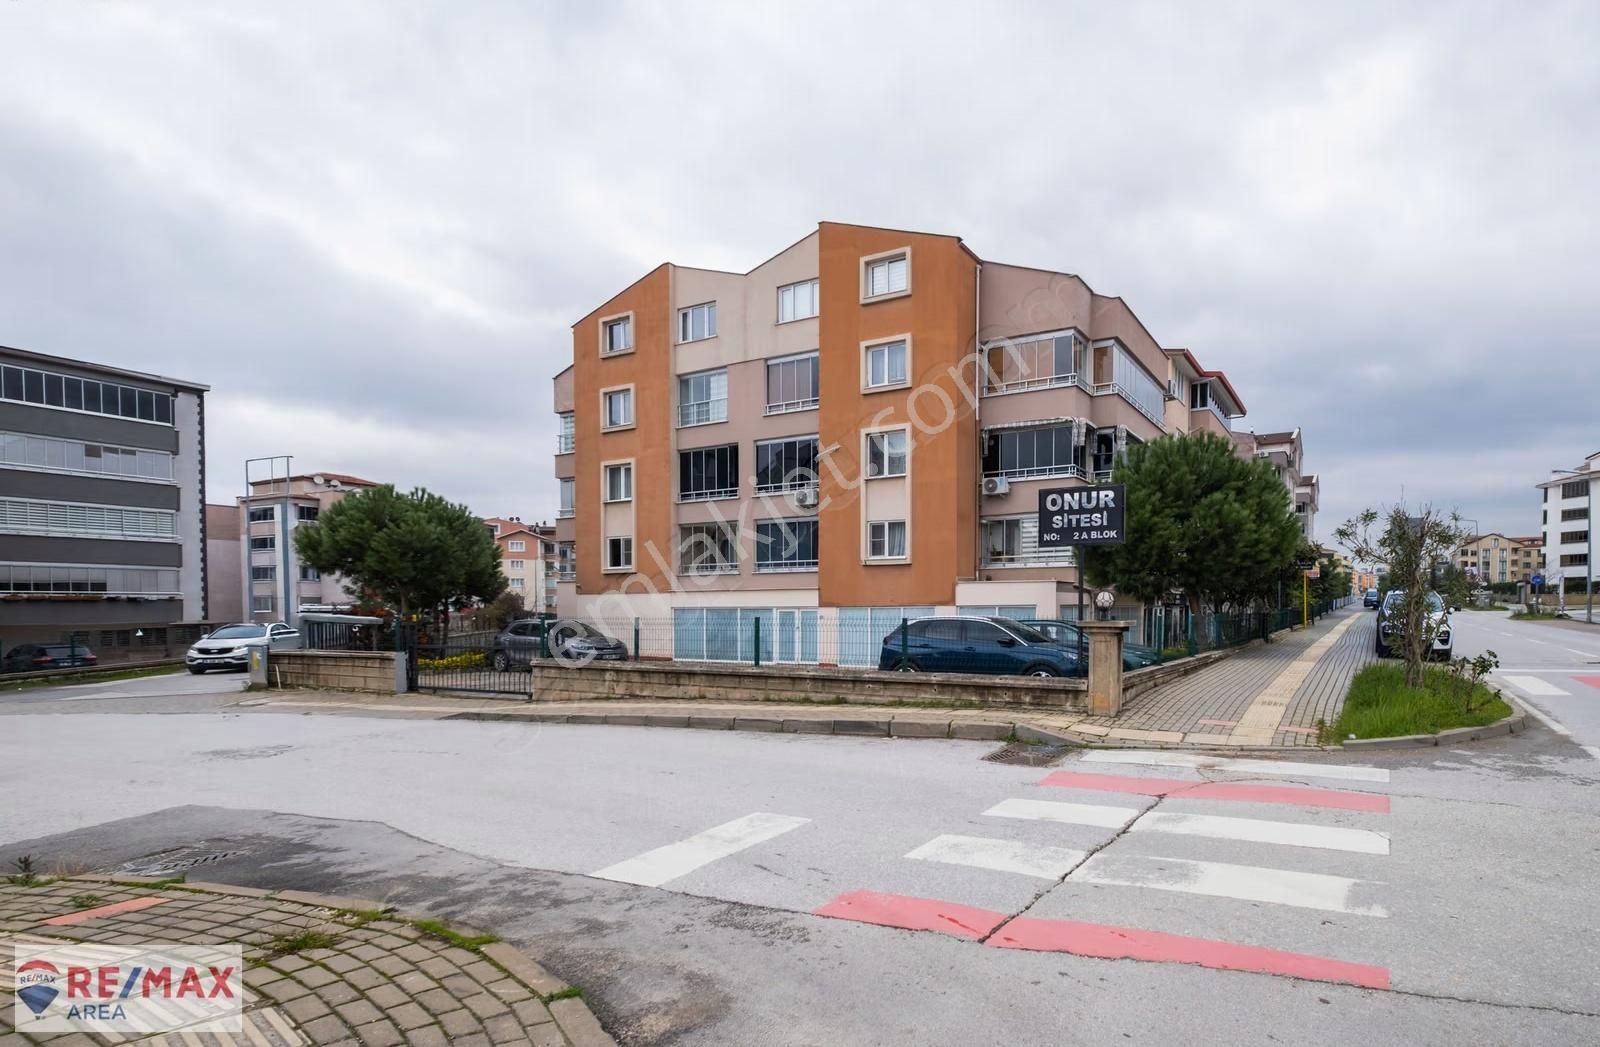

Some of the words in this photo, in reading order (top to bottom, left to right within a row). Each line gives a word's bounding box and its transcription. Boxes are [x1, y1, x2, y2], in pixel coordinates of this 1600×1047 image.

[1045, 490, 1116, 511] ONUR
[1043, 533, 1060, 541] NO:
[1090, 530, 1117, 539] BLOK
